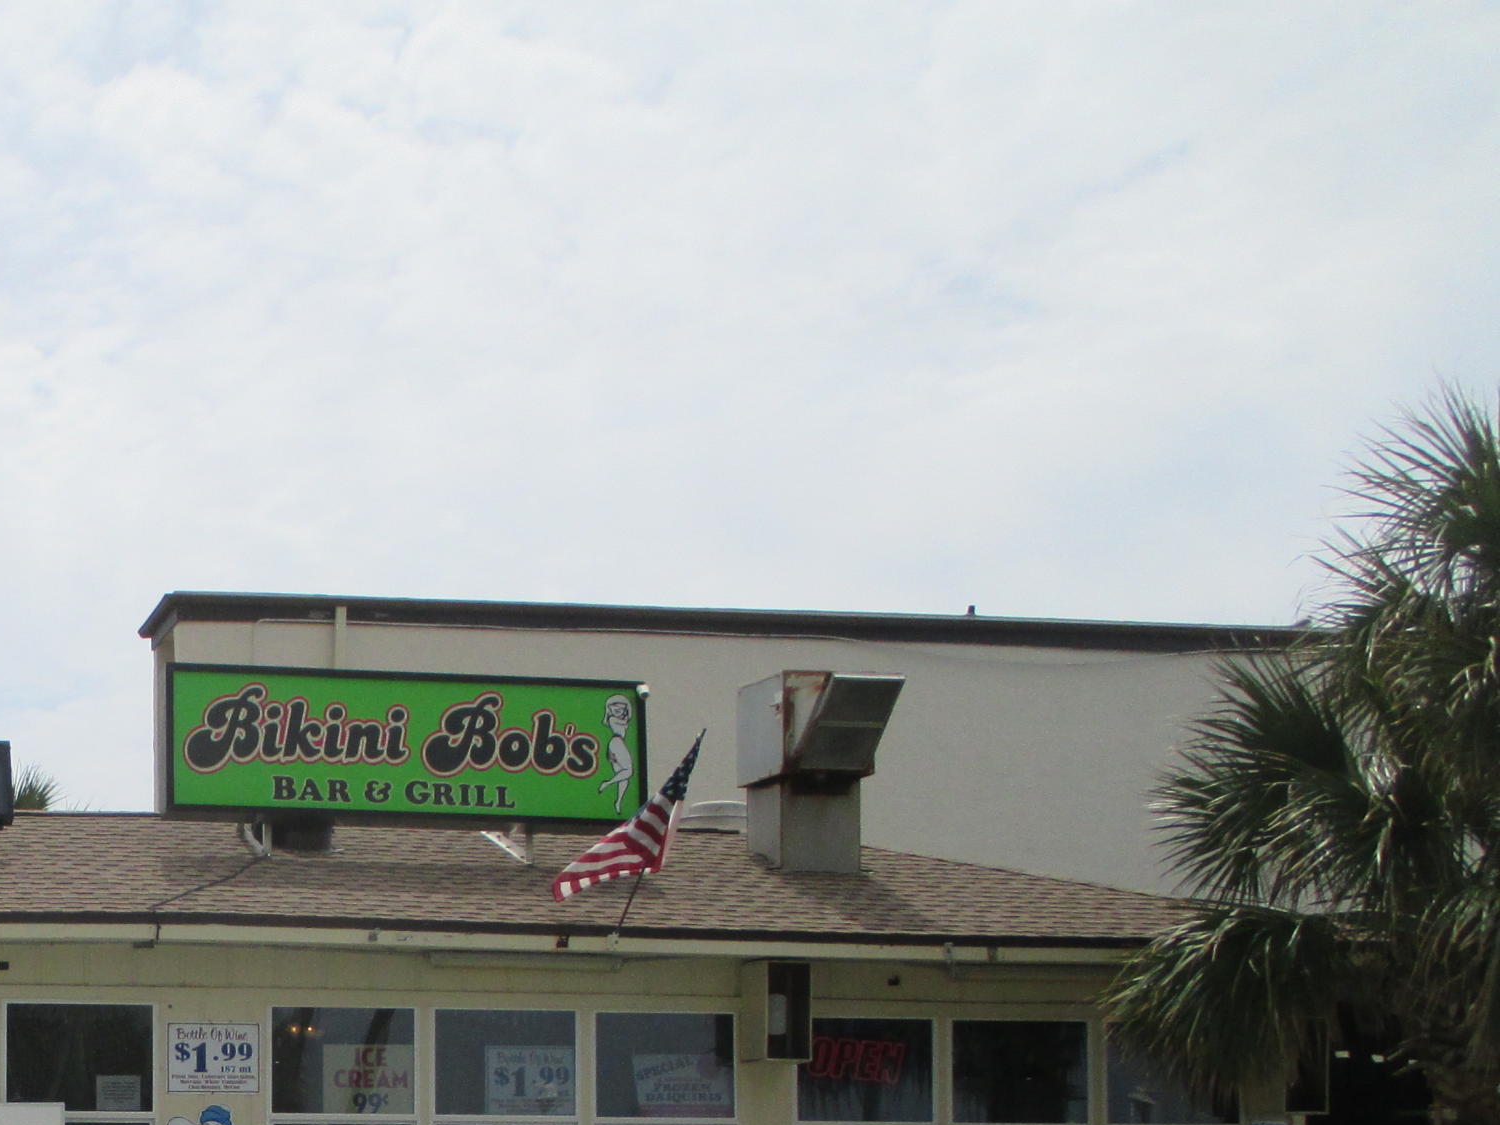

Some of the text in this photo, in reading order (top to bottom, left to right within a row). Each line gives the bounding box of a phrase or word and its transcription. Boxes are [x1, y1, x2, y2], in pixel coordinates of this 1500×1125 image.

[183, 682, 600, 777] Bikini Bob's
[273, 776, 515, 808] BAR & GRILL
[176, 1027, 207, 1040] Bottle
[174, 1041, 253, 1073] $1.99
[355, 1047, 388, 1067] ICE
[807, 1036, 906, 1084] OPEN
[333, 1069, 409, 1089] CREAM
